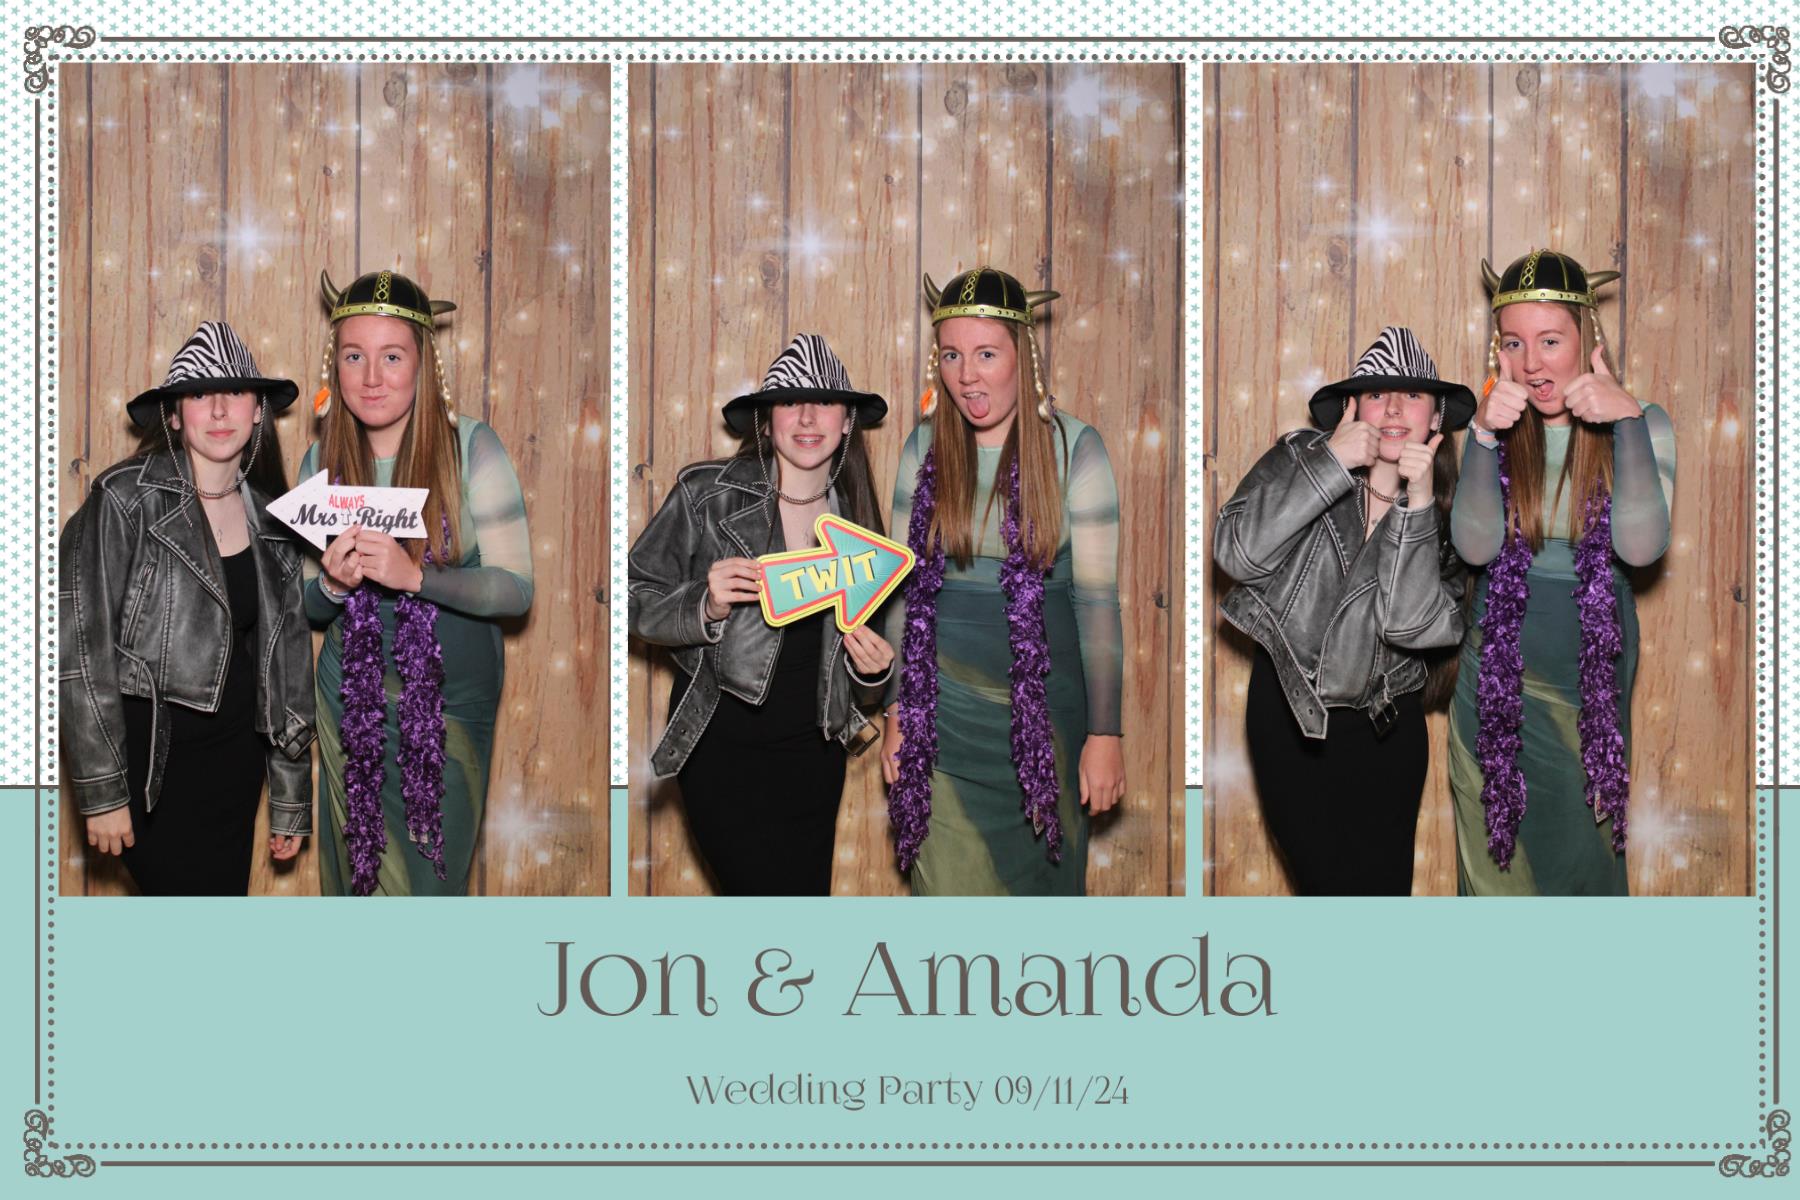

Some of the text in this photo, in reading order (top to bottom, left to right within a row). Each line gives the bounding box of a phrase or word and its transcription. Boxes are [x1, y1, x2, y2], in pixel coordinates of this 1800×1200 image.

[329, 494, 365, 509] ALWAYS
[290, 504, 418, 533] Mrs Right
[780, 549, 877, 600] TWIT
